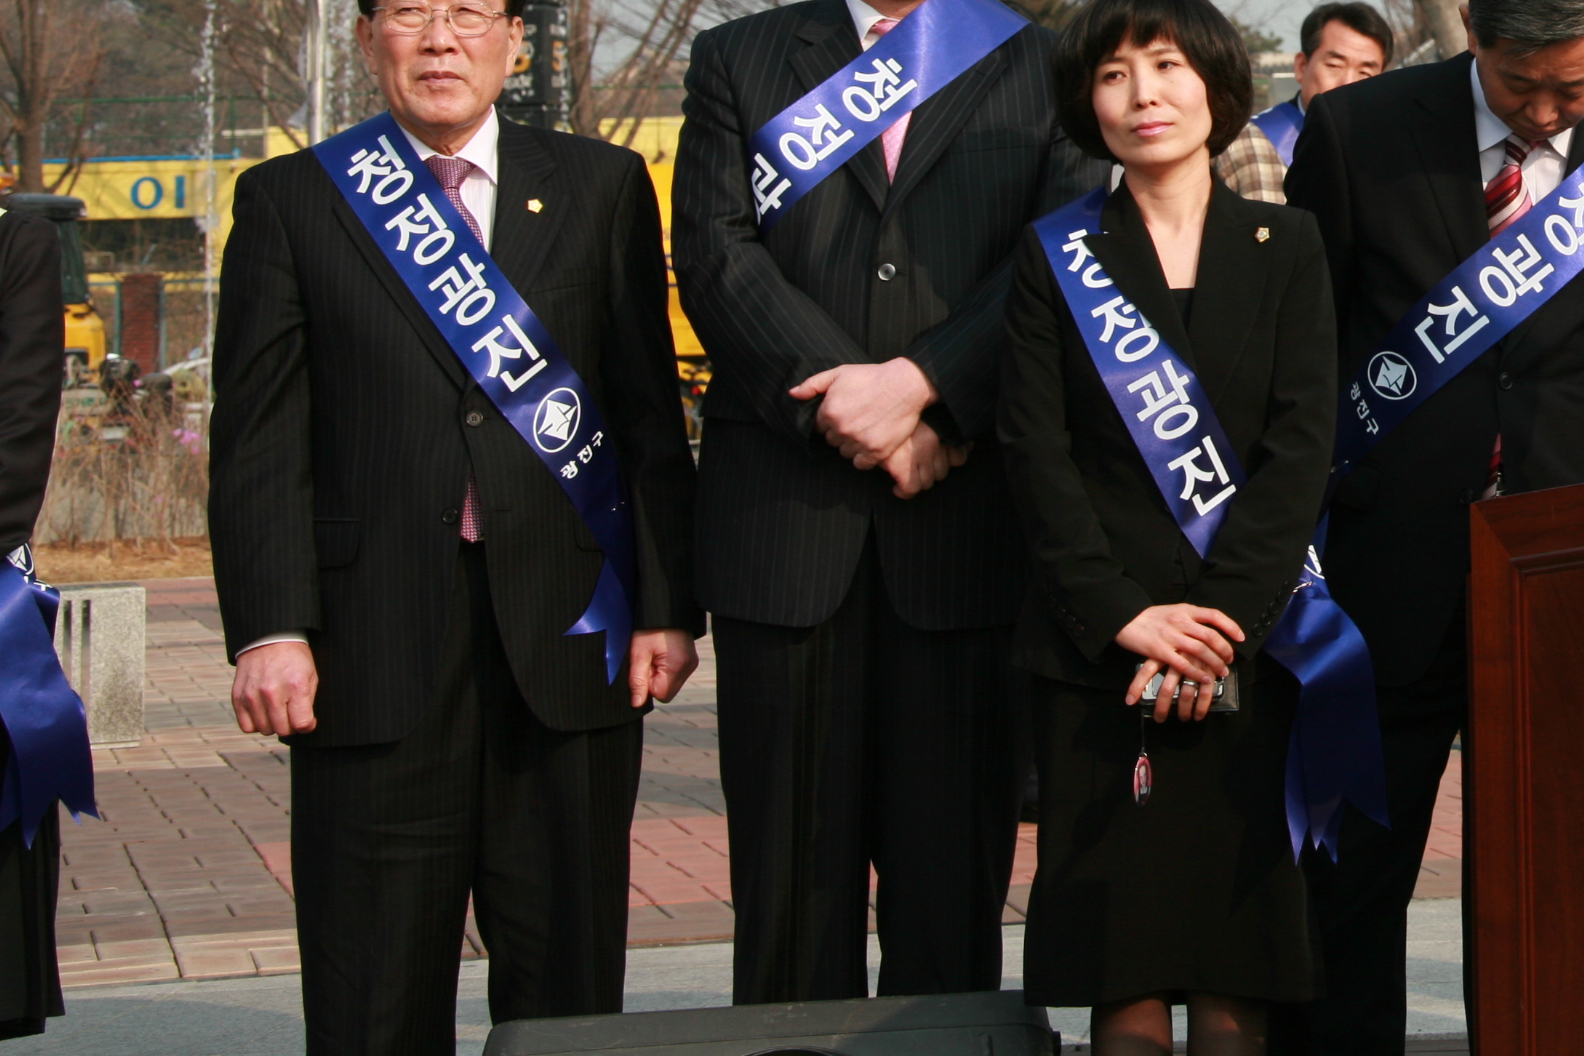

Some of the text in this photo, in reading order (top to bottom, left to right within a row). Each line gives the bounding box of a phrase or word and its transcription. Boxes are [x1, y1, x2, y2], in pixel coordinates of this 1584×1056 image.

[347, 135, 547, 392] 청정광진
[1350, 382, 1380, 435] 광진구
[559, 429, 605, 480] 광진구
